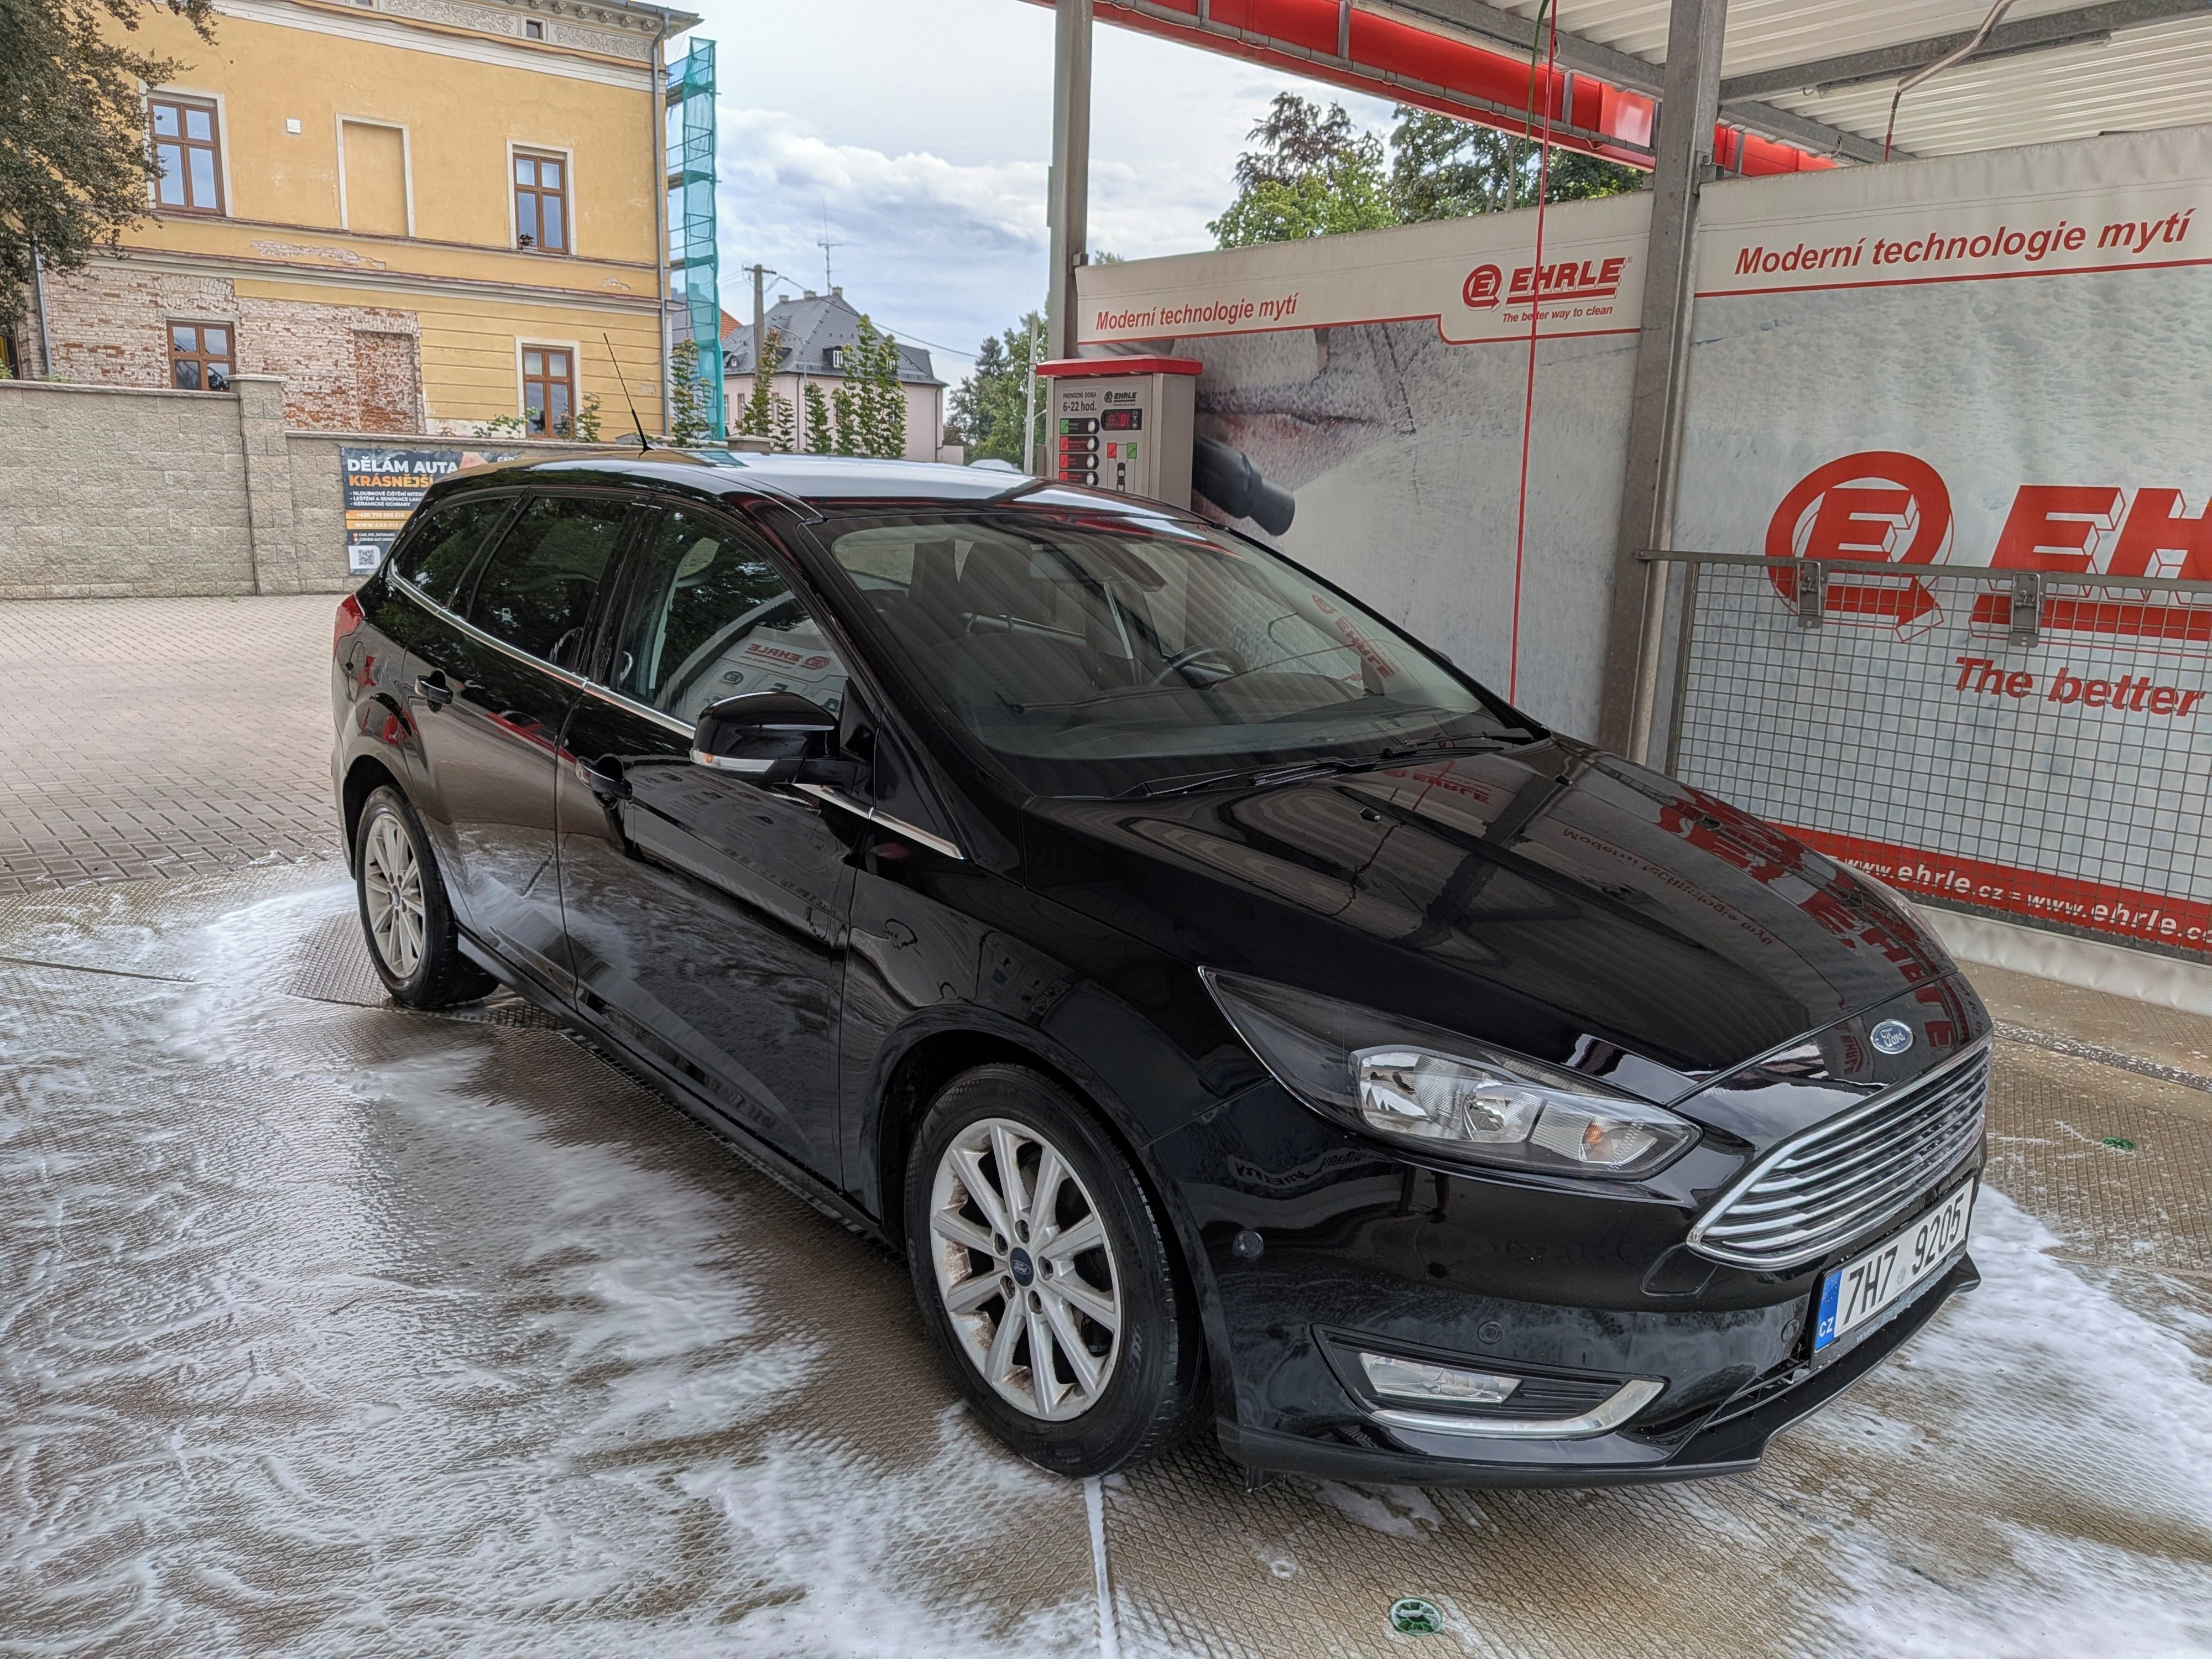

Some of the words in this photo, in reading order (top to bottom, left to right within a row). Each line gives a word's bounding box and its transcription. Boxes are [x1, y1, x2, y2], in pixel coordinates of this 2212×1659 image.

[1734, 237, 1866, 276] Moderní
[1872, 220, 2086, 267] technologie
[2097, 208, 2197, 256] mytí
[1509, 257, 1626, 295] EHRLE
[1095, 306, 1157, 330] Moderní
[1160, 298, 1254, 325] technologie
[1258, 293, 1300, 321] mytí
[1503, 313, 1519, 323] The
[1521, 311, 1549, 321] beter
[1552, 310, 1571, 321] way
[1573, 307, 1583, 317] to
[1586, 305, 1613, 316] clean
[1063, 401, 1079, 411] 6-22
[1081, 401, 1097, 411] hod.
[347, 456, 409, 473] DĚLÁM
[413, 461, 458, 474] AUTA
[349, 473, 434, 488] KRÁSNĚJŠÍ
[1955, 656, 2033, 698] The
[2047, 666, 2205, 717] better
[1880, 1027, 1906, 1047] Ford
[1843, 1244, 1898, 1326] 7H7
[1912, 1191, 1965, 1276] 9205
[1819, 1316, 1834, 1338] CZ
